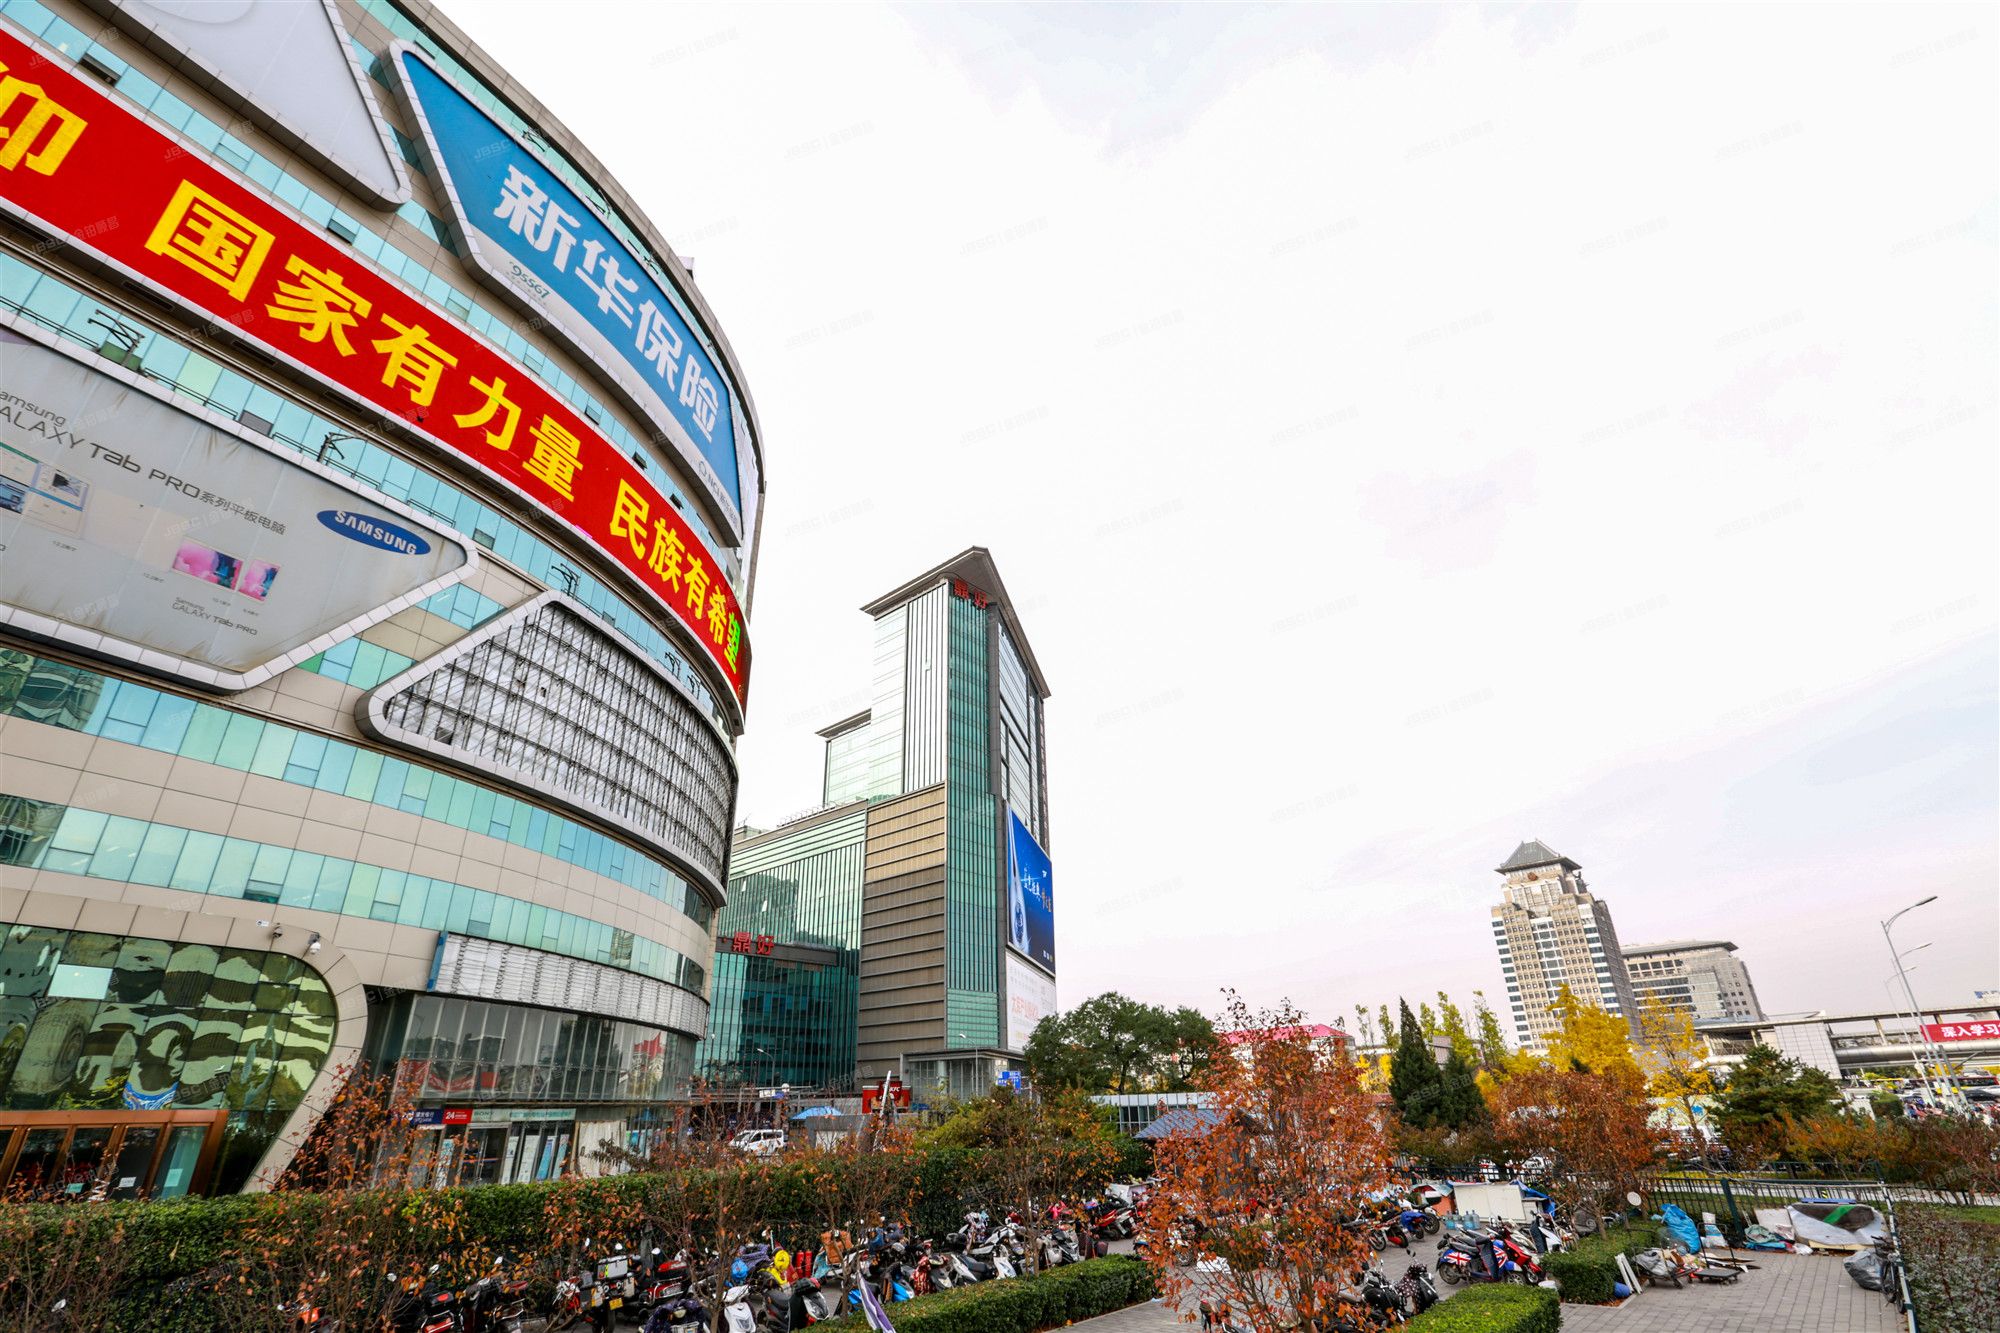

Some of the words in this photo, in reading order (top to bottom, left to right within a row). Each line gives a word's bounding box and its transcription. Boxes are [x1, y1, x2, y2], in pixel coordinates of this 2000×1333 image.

[511, 264, 551, 299] 95567
[493, 163, 719, 443] 新华保险
[144, 179, 583, 502] 国家有力量
[610, 479, 741, 674] 民族有希望
[89, 442, 142, 474] Tab
[334, 510, 418, 556] SAMSUNG
[171, 602, 211, 621] GALAXY
[213, 615, 233, 628] Tab
[235, 623, 258, 636] PRO
[732, 931, 776, 956] 鼎好
[1941, 1023, 2000, 1038] 深入学习
[445, 1111, 455, 1120] 24
